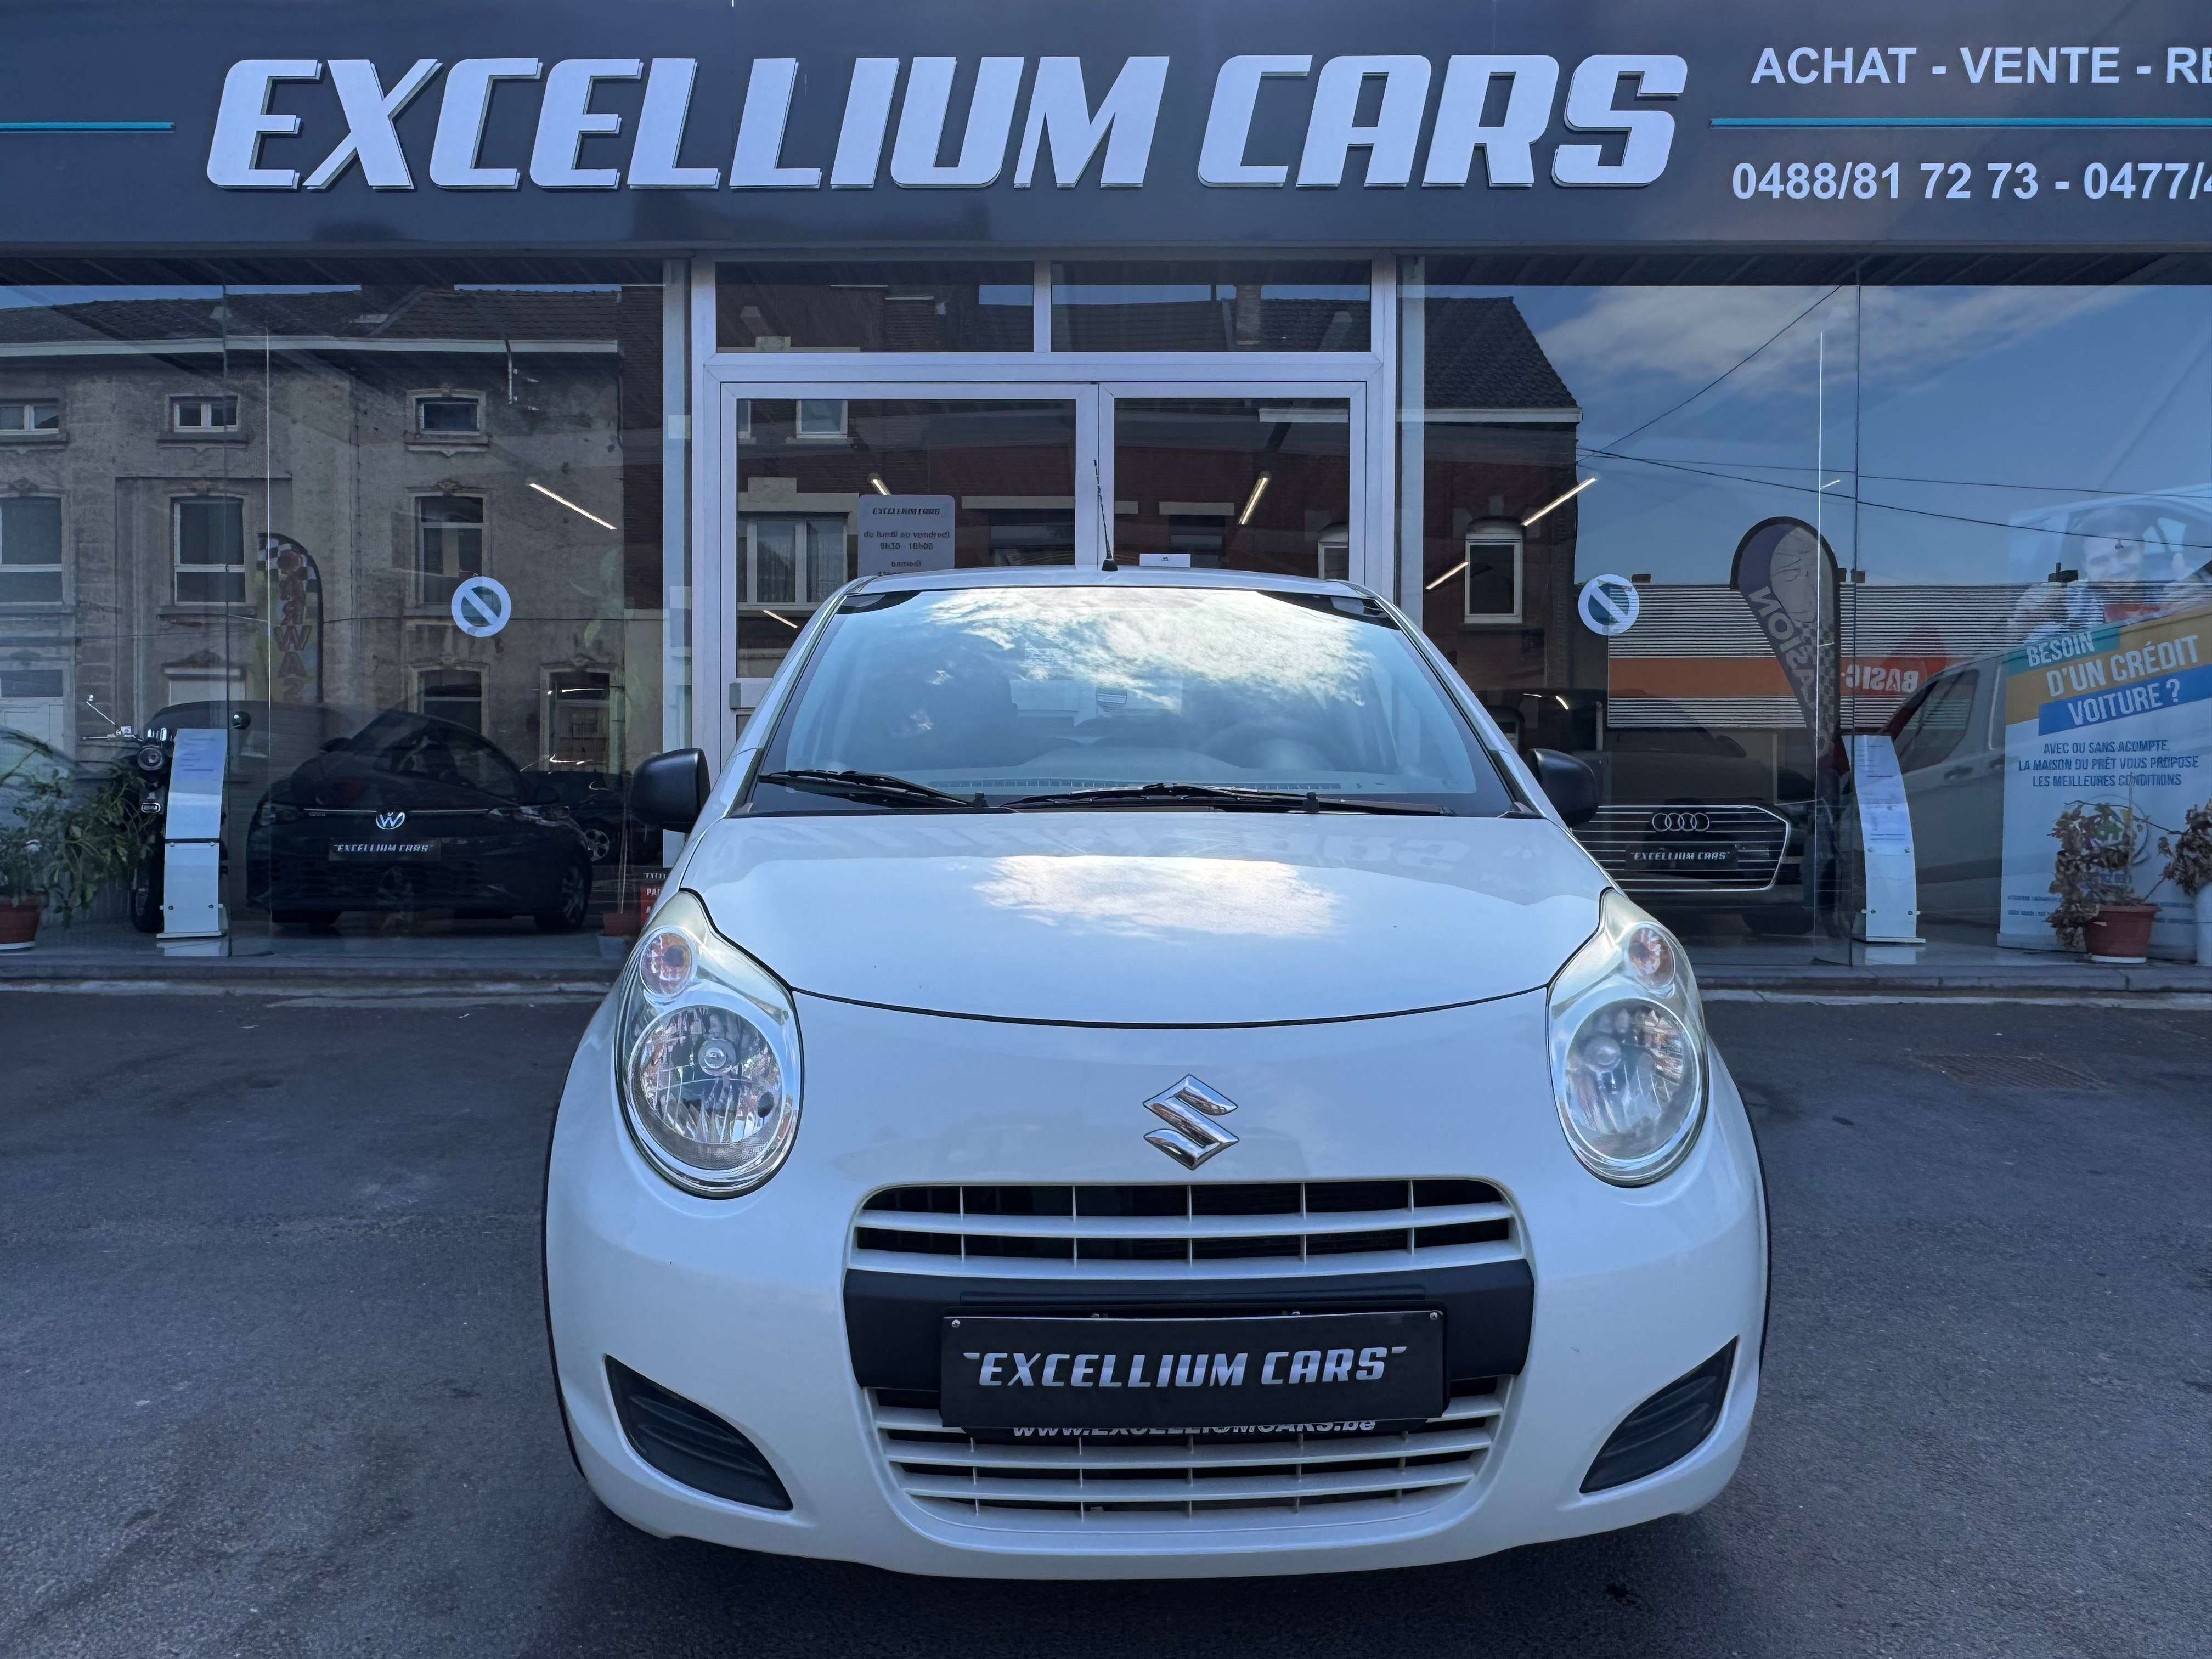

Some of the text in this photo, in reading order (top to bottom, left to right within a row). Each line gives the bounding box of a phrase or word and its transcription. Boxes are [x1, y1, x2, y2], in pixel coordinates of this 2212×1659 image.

[1750, 46, 1917, 84] ACHAT
[1960, 46, 2120, 84] VENTE
[207, 55, 1688, 190] EXCELLIUM CARS
[1731, 161, 1900, 200] 0488/81
[1920, 162, 1971, 199] 72
[1987, 162, 2039, 199] 73
[2026, 630, 2095, 667] BESOIN
[2046, 634, 2199, 697] D'UN CRÉDIT
[2068, 682, 2163, 725] VOITURE
[2018, 759, 2030, 771] LA
[2033, 759, 2072, 771] MAISON
[2075, 758, 2089, 770] DU
[2120, 758, 2147, 769] VOUS
[2149, 755, 2199, 769] PROPOSE
[2043, 740, 2169, 754] AVEC OU SANS ACOMPTE
[2032, 775, 2051, 787] LES
[2053, 774, 2115, 786] MEILLEURES
[337, 844, 397, 852] EXCELLIUM
[1633, 851, 1695, 861] EXCELLIUM
[979, 1347, 1387, 1387] EXCELLIUM CARS
